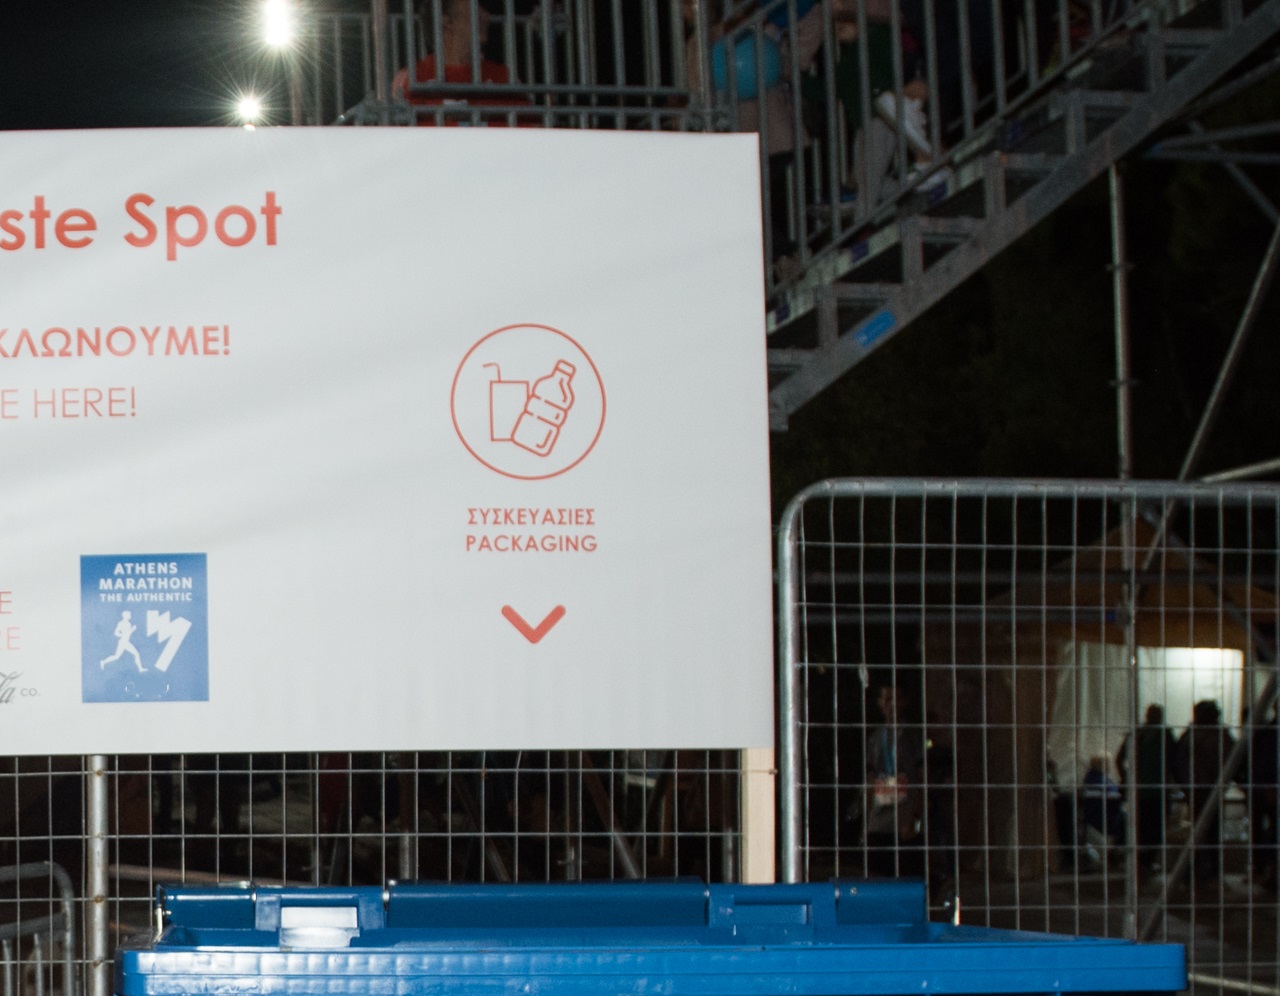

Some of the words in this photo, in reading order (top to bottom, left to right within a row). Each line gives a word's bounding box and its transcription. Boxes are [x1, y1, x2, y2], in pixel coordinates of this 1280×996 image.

[123, 191, 282, 262] Spot
[32, 386, 137, 420] HERE!
[467, 507, 596, 527] ΣΥΣΚΕΥΑΣΙΕΣ
[465, 533, 598, 554] PACKAGING
[113, 562, 178, 576] ATHENS
[99, 577, 193, 591] MARATHON
[100, 593, 123, 603] THE
[127, 592, 193, 603] AUTHENTIC
